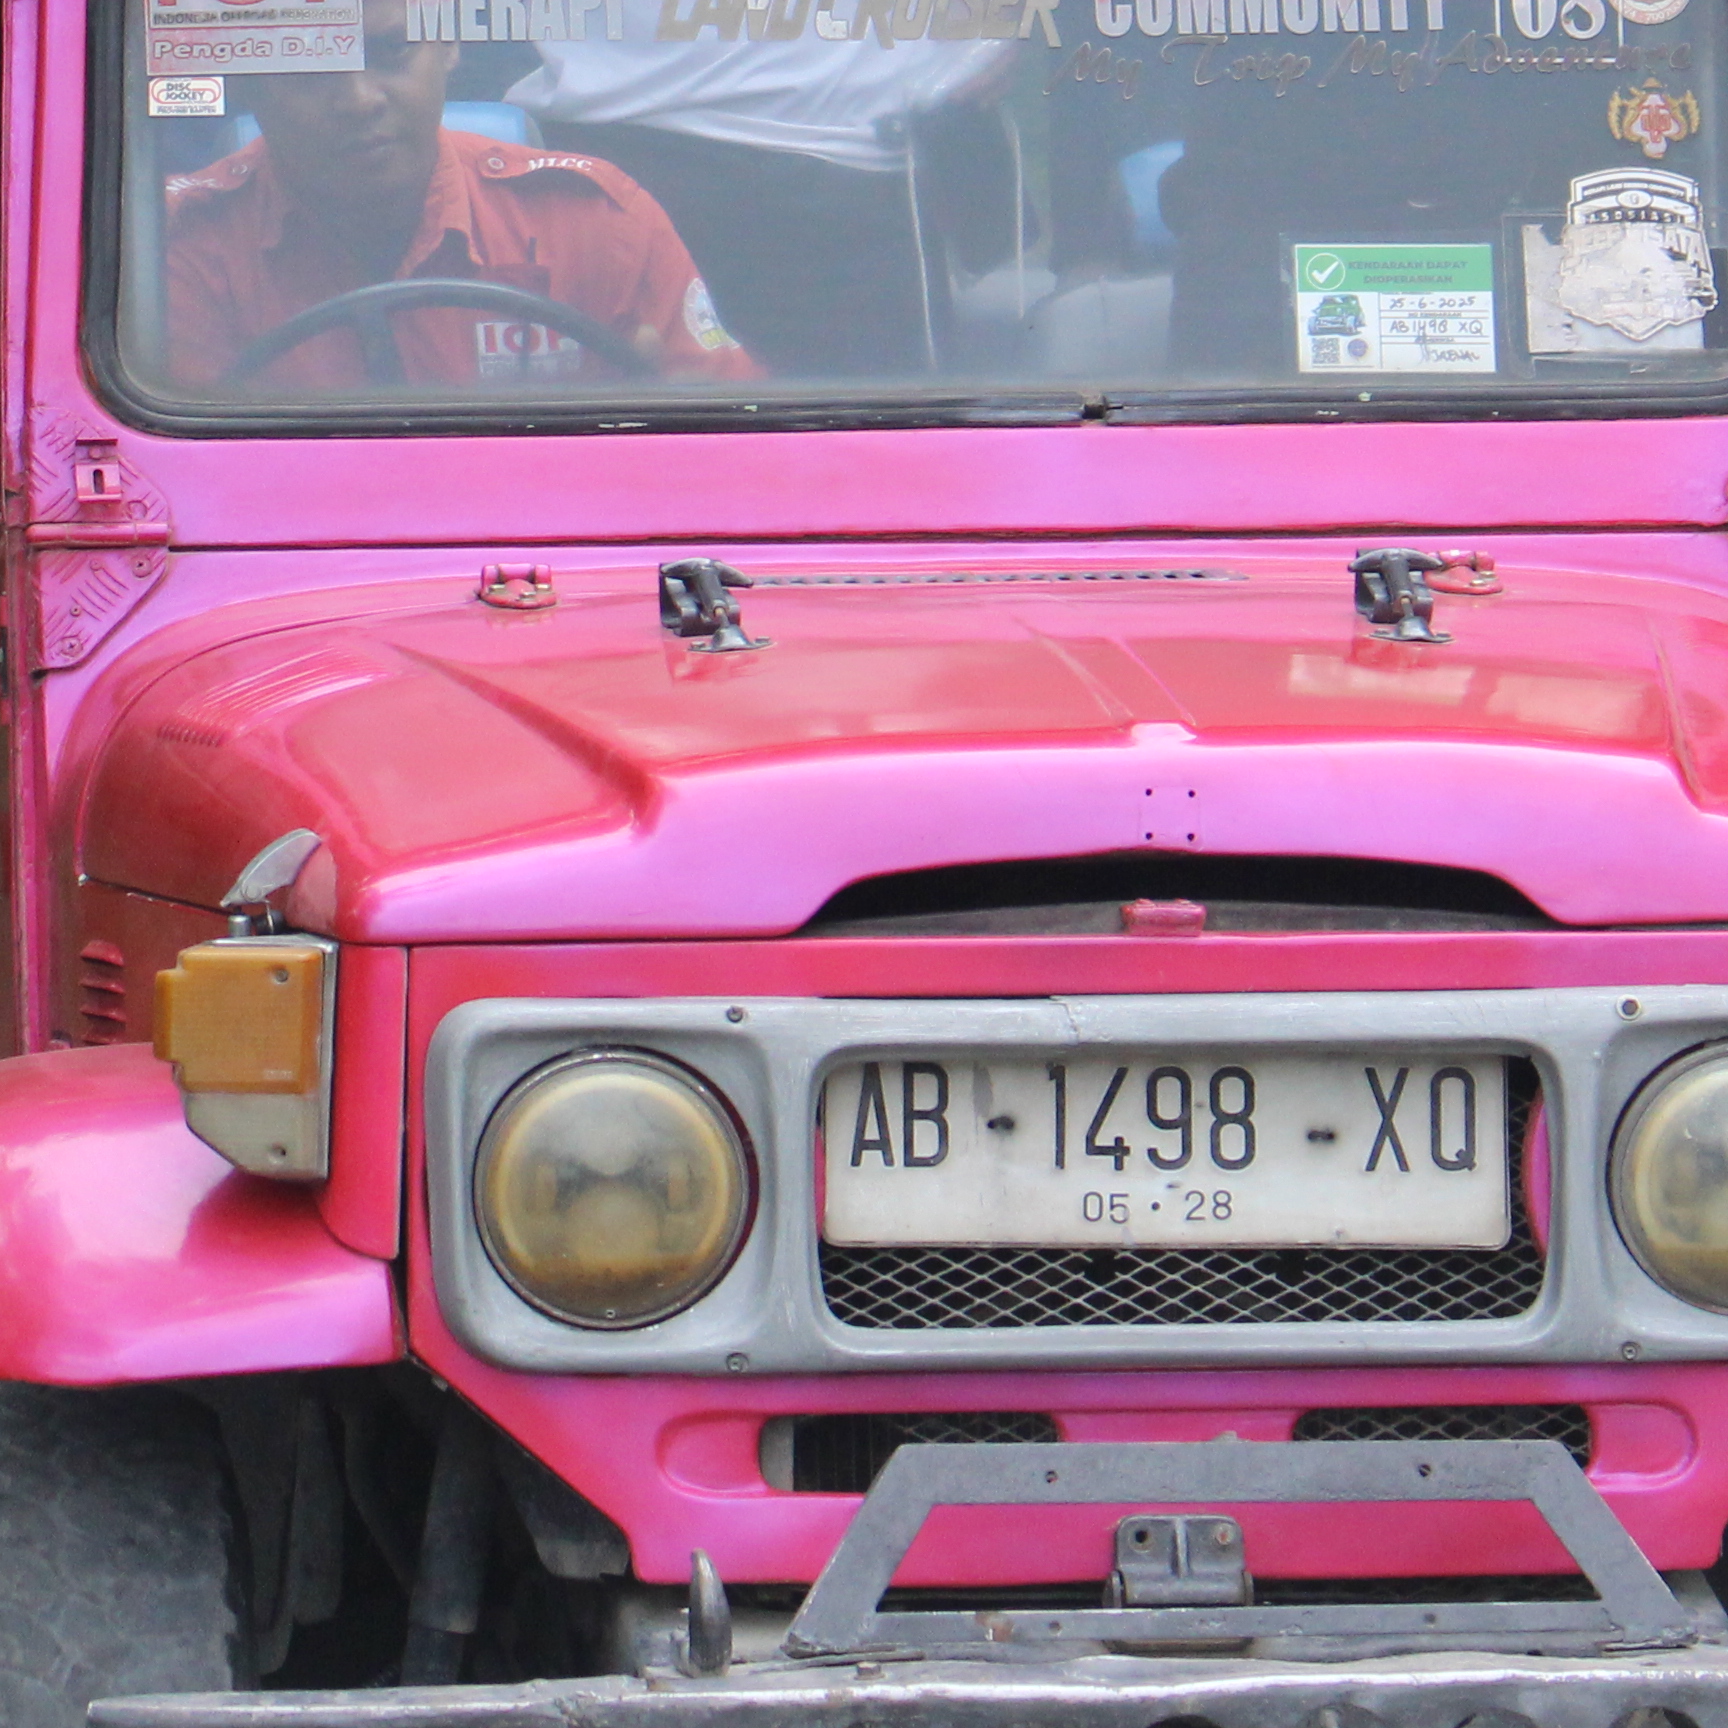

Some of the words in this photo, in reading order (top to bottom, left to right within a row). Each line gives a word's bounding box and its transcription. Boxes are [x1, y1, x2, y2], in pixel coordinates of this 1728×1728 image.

[152, 38, 273, 63] Pengda
[282, 35, 356, 57] D.I.Y
[1042, 41, 1143, 100] My
[1161, 35, 1311, 98] Trip
[1317, 35, 1419, 93] My
[849, 1061, 950, 1168] AB
[1048, 1066, 1257, 1171] 1498
[1363, 1066, 1478, 1173] XQ
[1082, 1191, 1131, 1224] 05
[1183, 1191, 1234, 1221] 28
